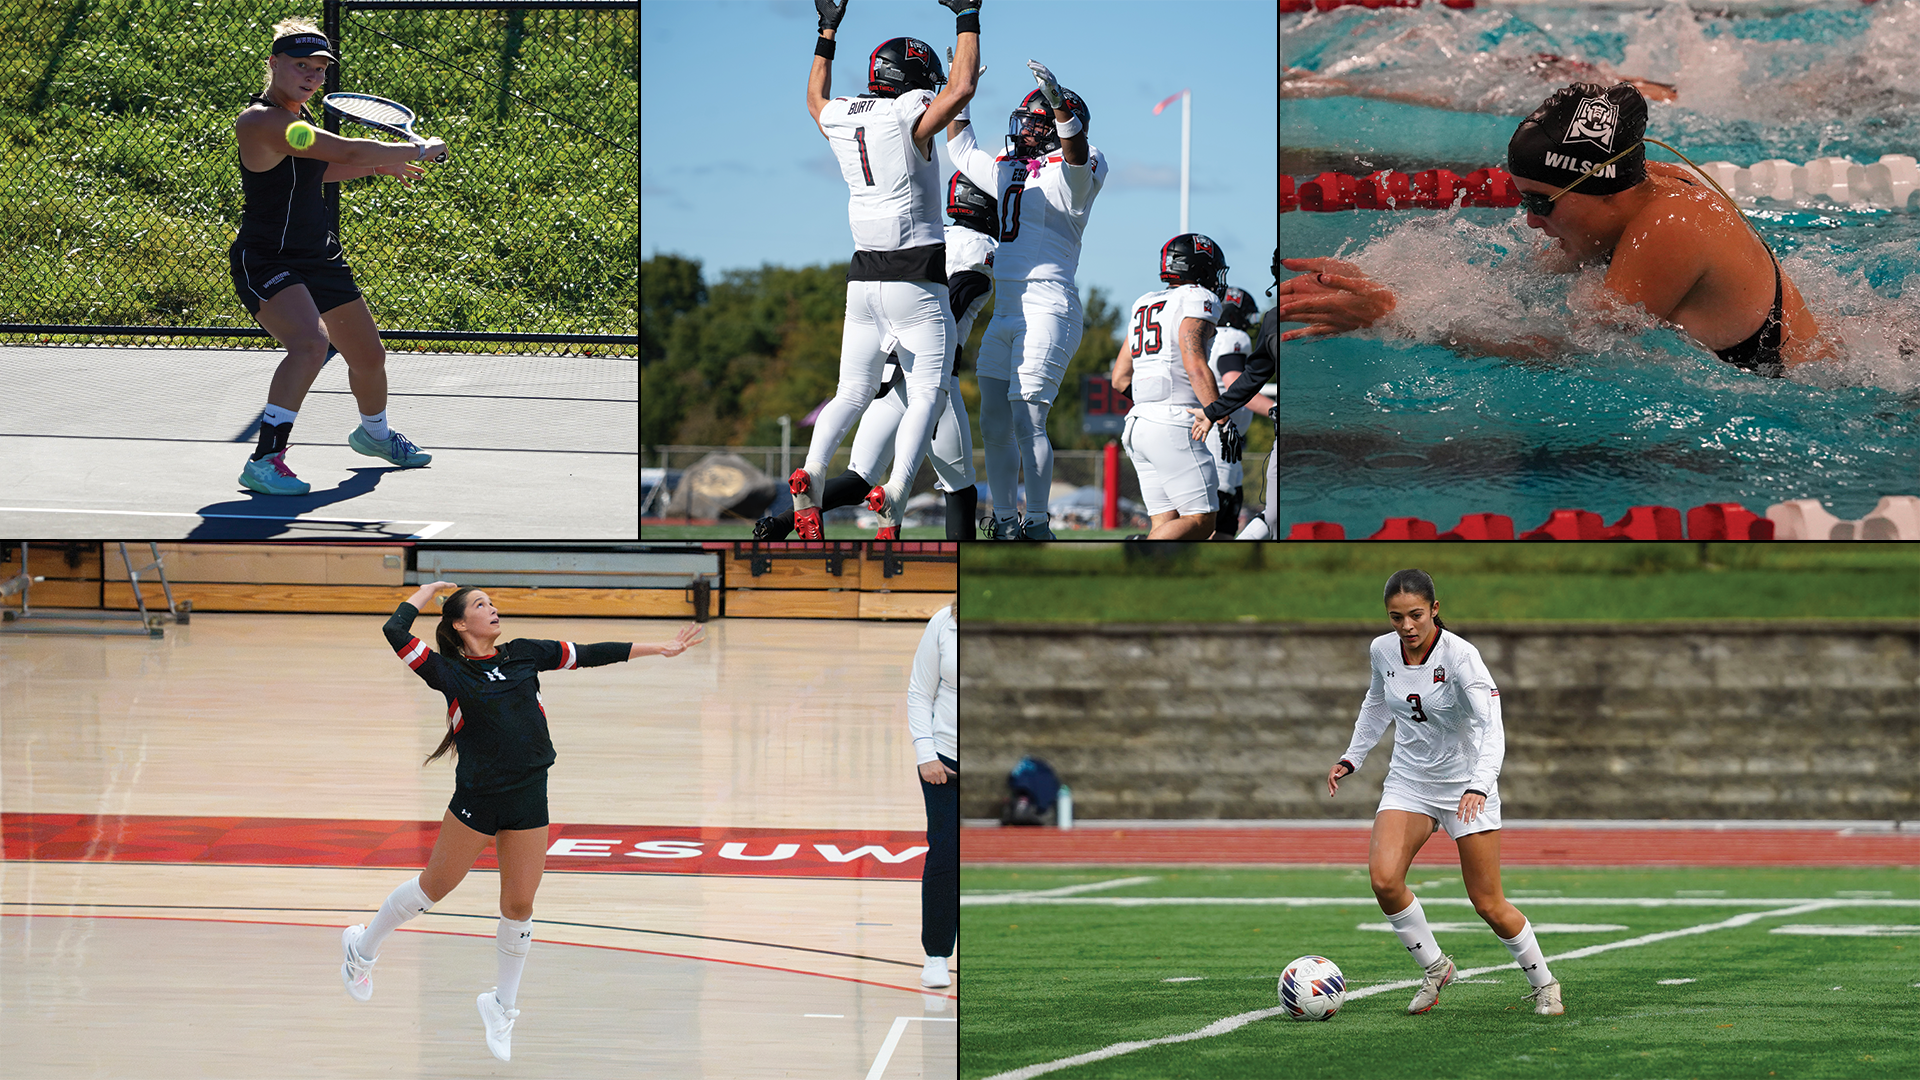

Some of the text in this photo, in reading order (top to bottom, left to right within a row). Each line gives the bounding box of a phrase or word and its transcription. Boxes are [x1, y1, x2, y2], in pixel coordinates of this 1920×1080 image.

[847, 99, 877, 115] BURTI
[853, 126, 876, 187] 1
[1544, 151, 1616, 179] WILSON
[1000, 184, 1025, 242] 0
[1131, 300, 1167, 359] 35
[1406, 693, 1428, 724] 3
[546, 838, 930, 864] ESUW
